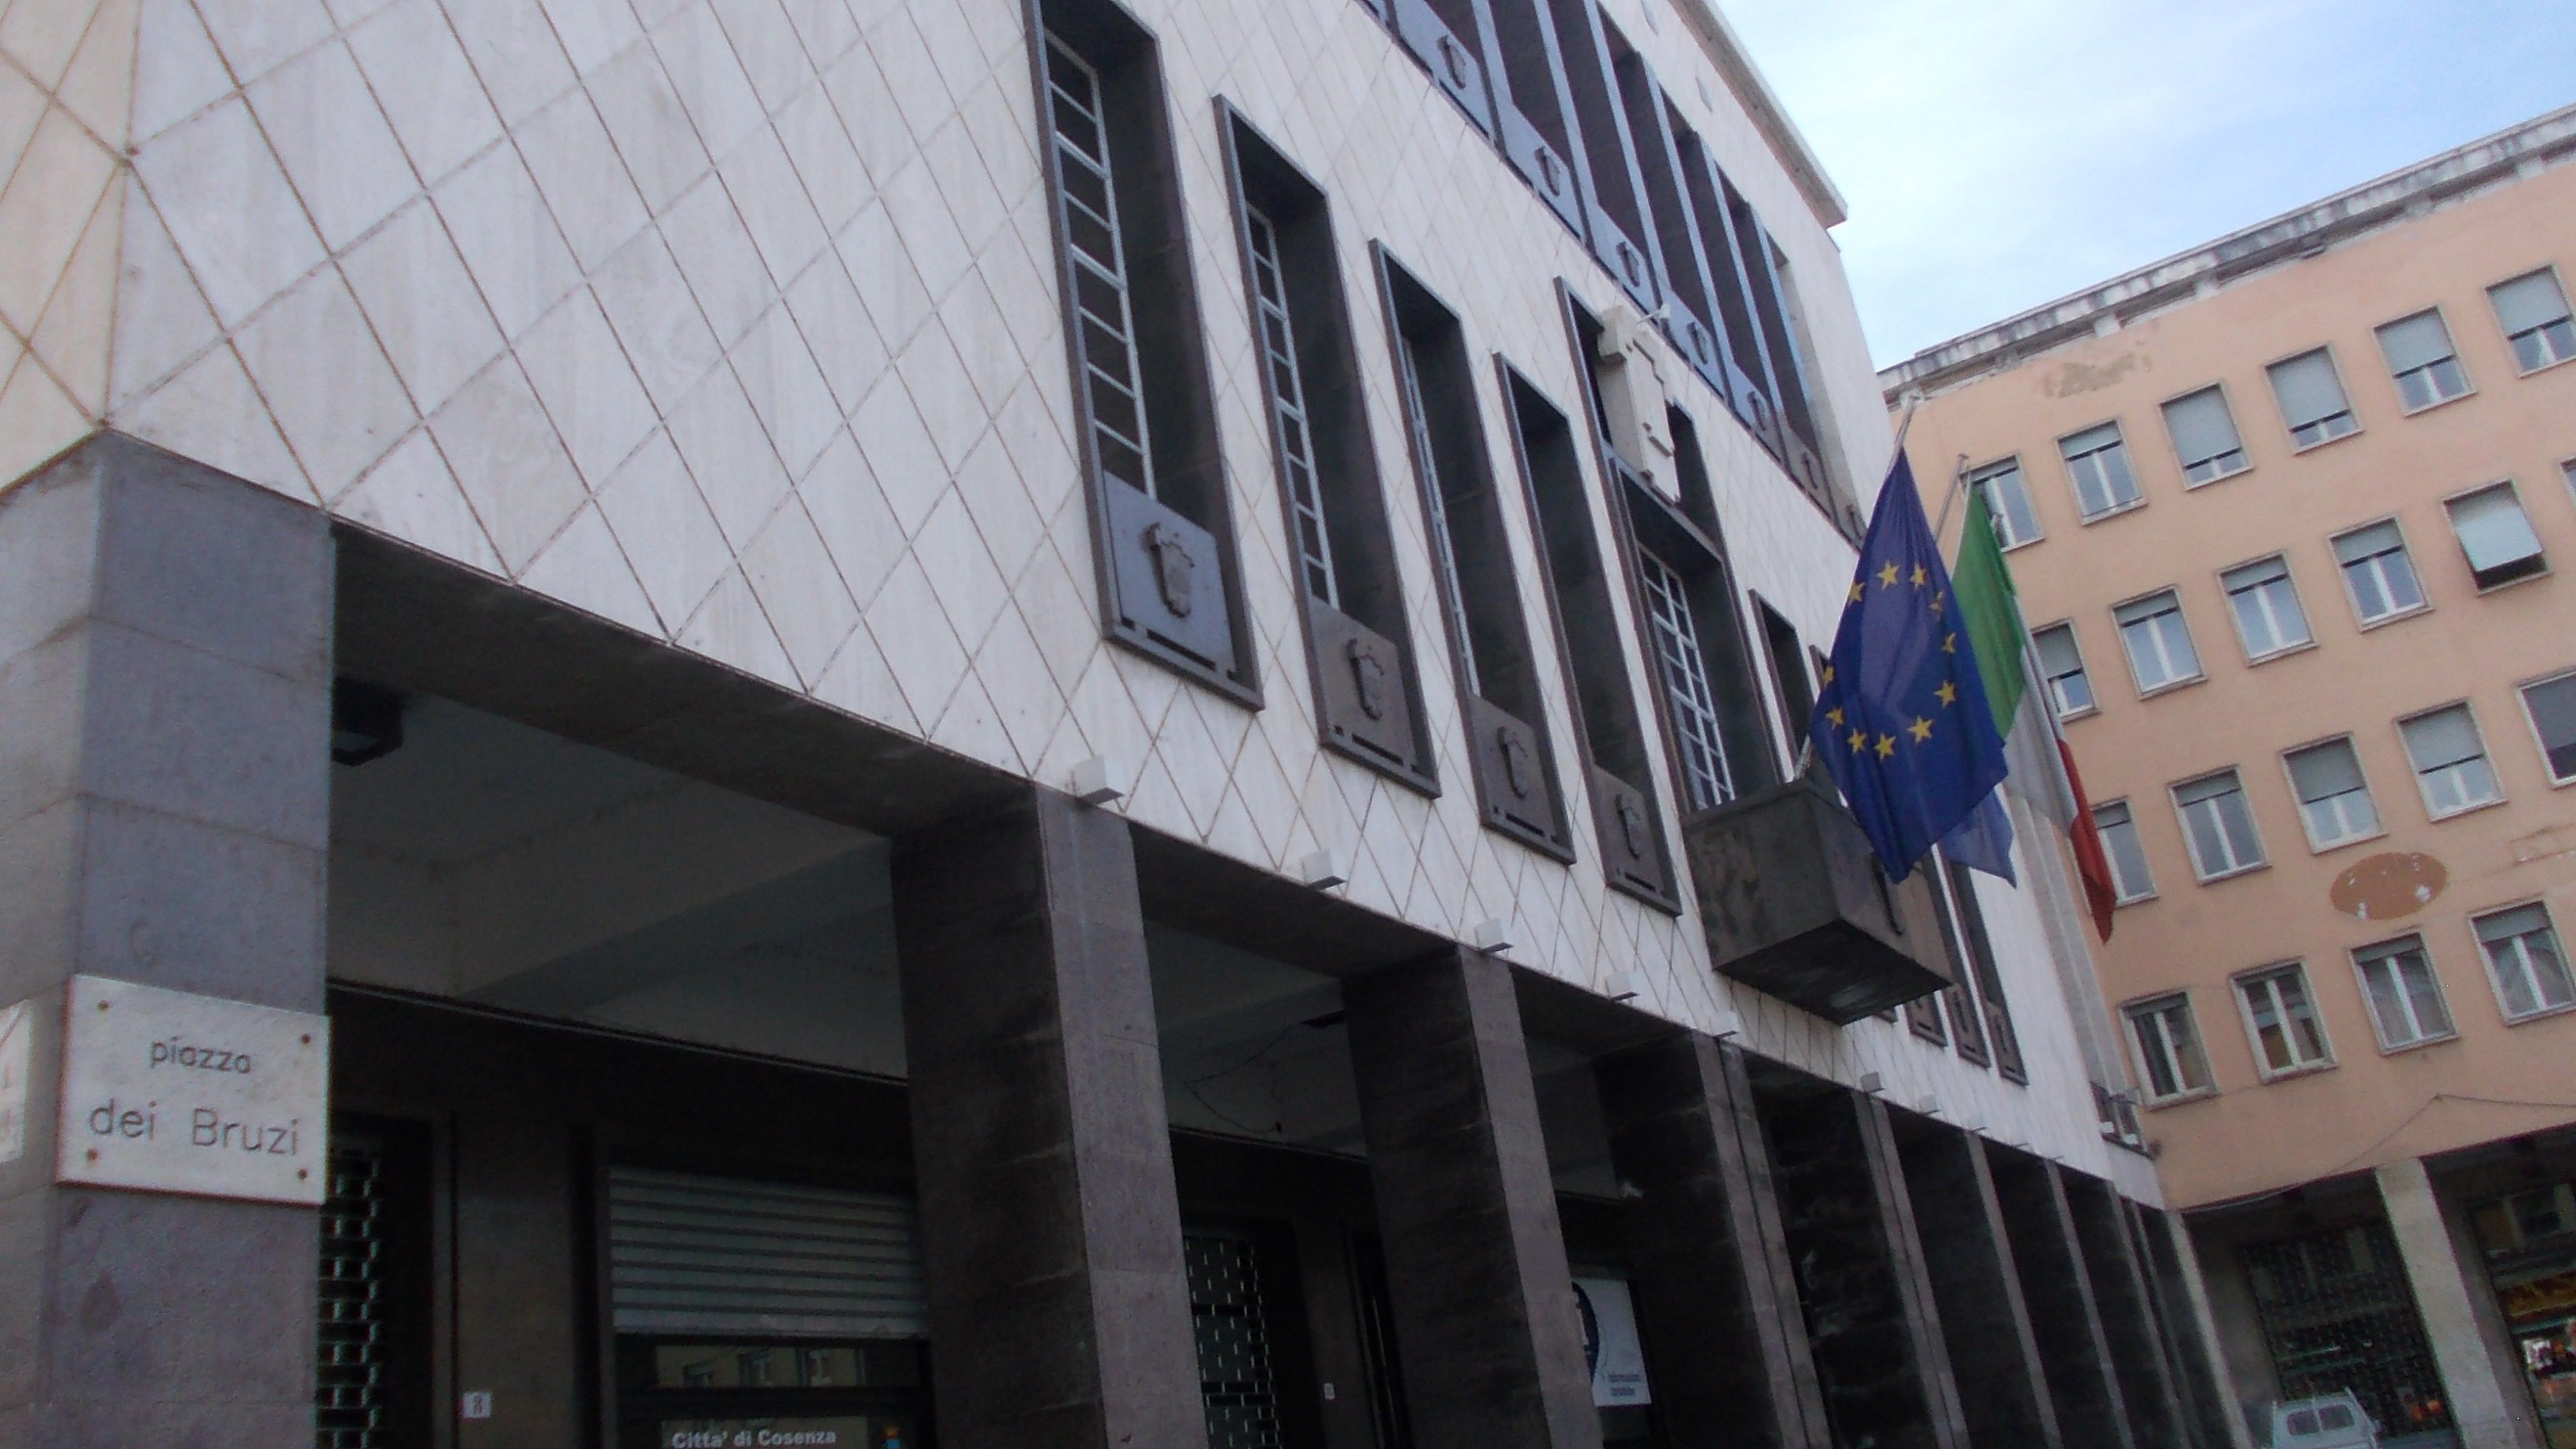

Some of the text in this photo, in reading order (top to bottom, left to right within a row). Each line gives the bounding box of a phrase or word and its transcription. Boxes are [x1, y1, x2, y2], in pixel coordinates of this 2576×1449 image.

[150, 1035, 251, 1075] piazza
[89, 1098, 299, 1156] dei Bruzi
[733, 1430, 752, 1447] di
[758, 1428, 837, 1446] Cosenza
